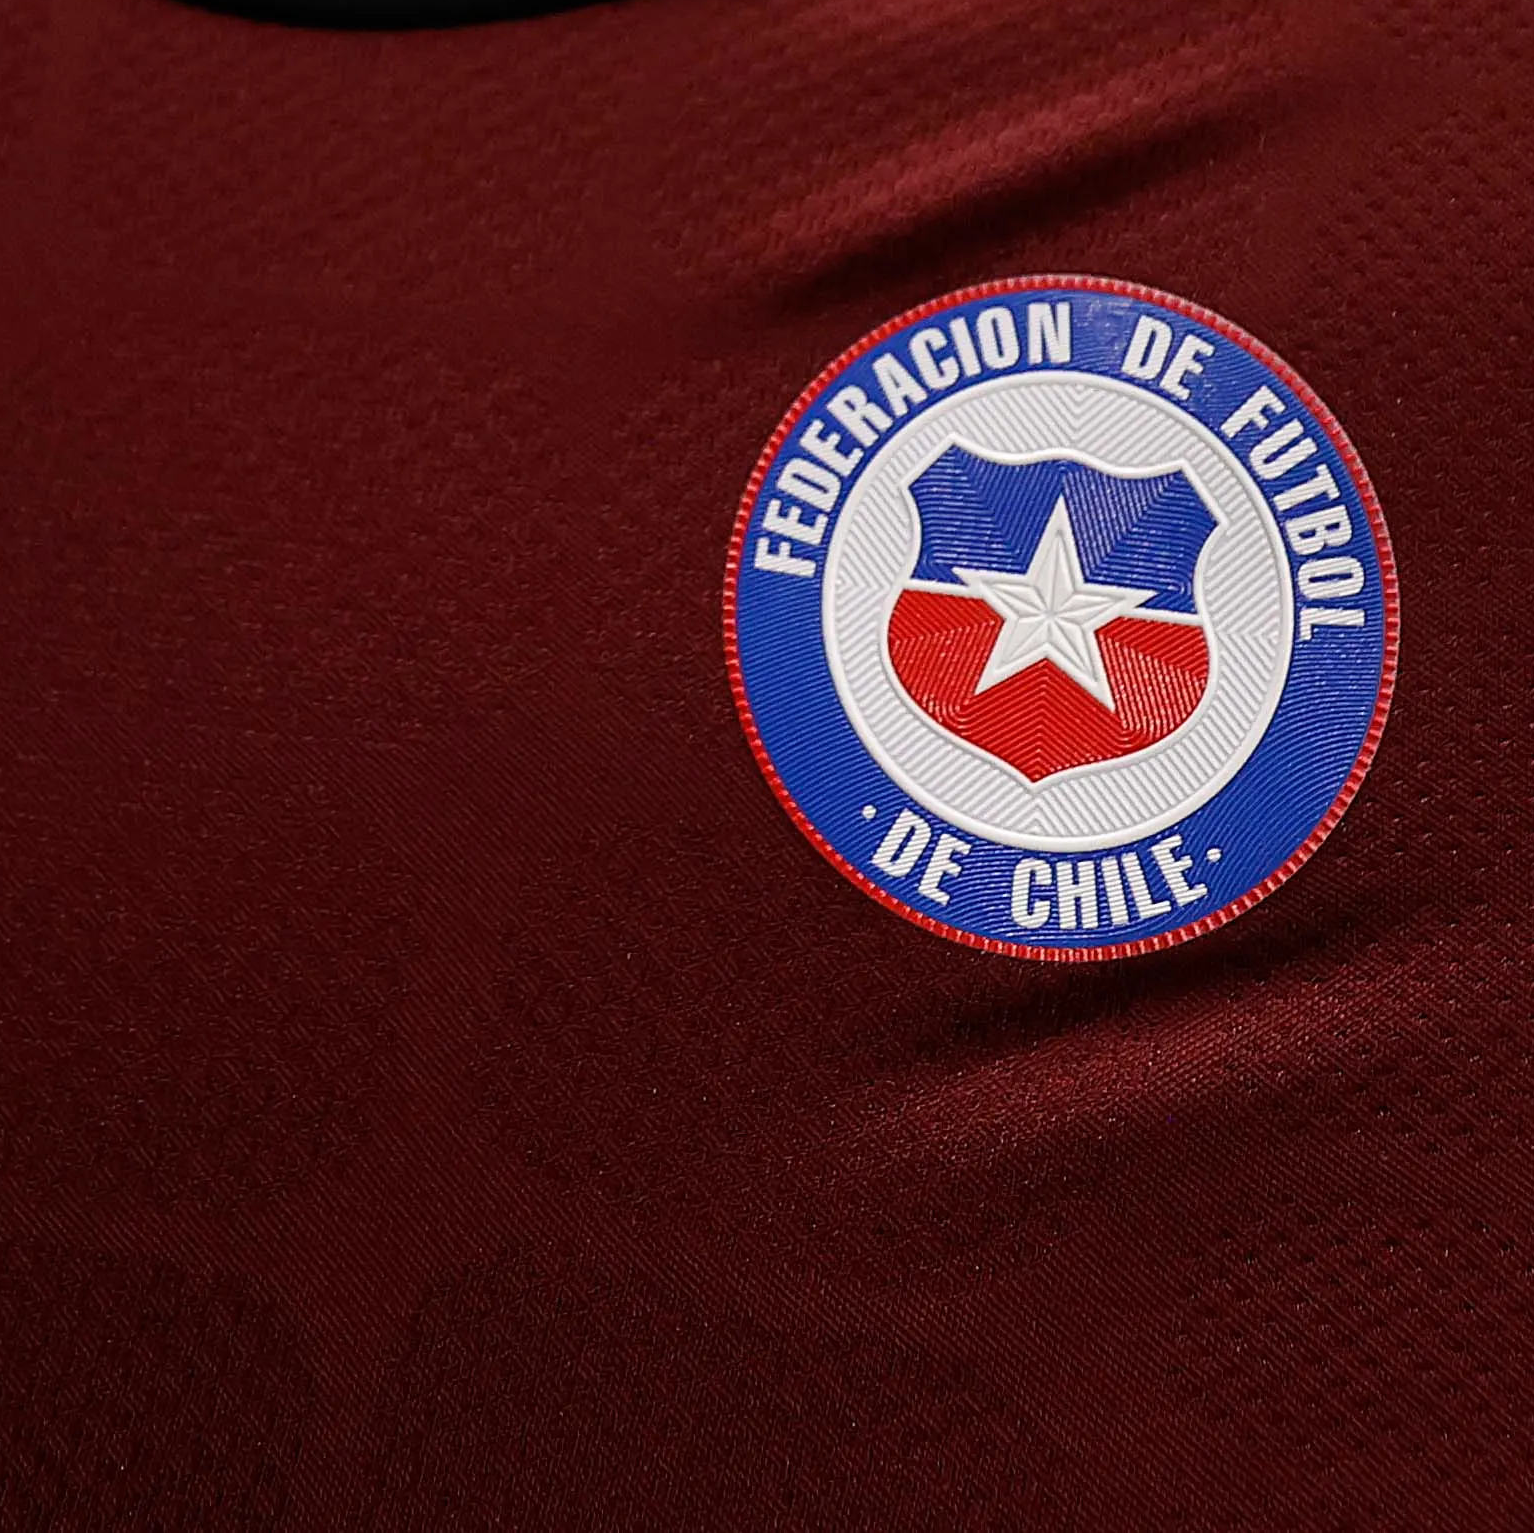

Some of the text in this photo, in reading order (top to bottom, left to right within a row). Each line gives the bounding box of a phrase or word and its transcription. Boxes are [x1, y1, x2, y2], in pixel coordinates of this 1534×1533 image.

[754, 302, 1365, 642] FEDERACION DE FUTBOL
